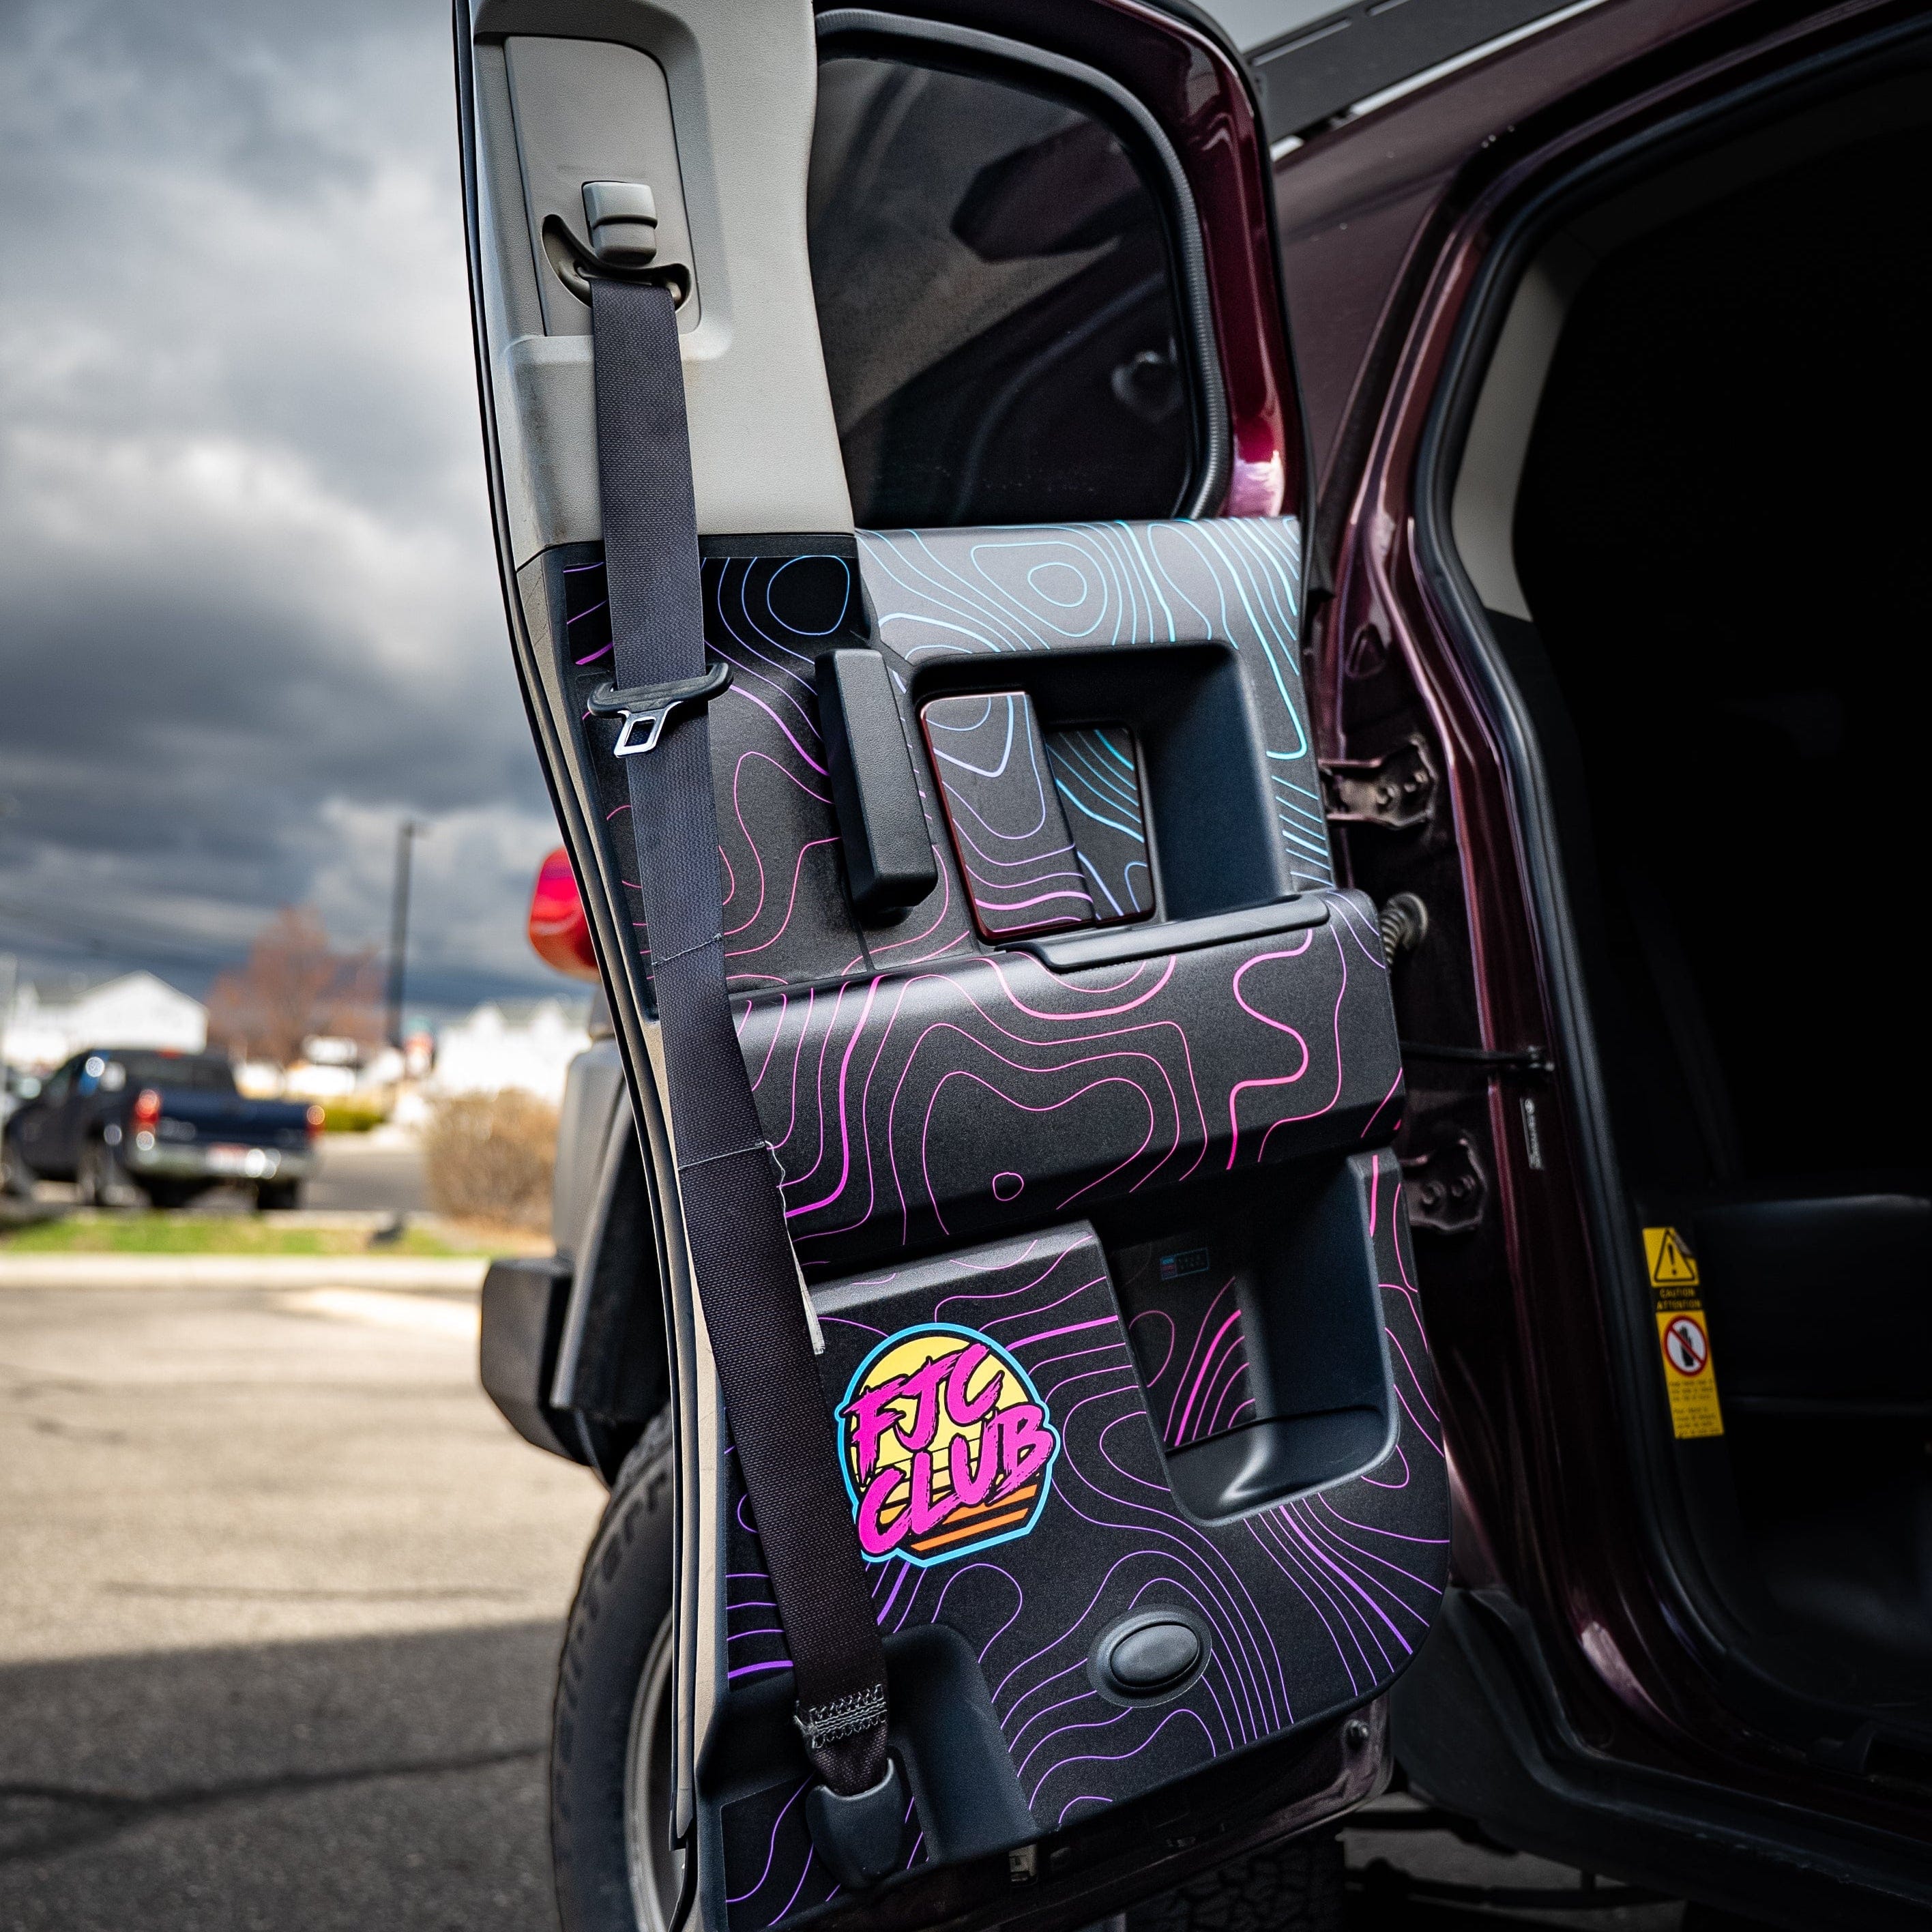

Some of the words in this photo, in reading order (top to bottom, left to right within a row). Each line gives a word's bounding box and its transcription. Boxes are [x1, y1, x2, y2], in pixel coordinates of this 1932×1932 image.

[1656, 1299, 1701, 1310] ATTENTION
[1659, 1287, 1695, 1298] CAUTION
[843, 1343, 1004, 1482] FJC
[859, 1405, 1053, 1553] CLUB
